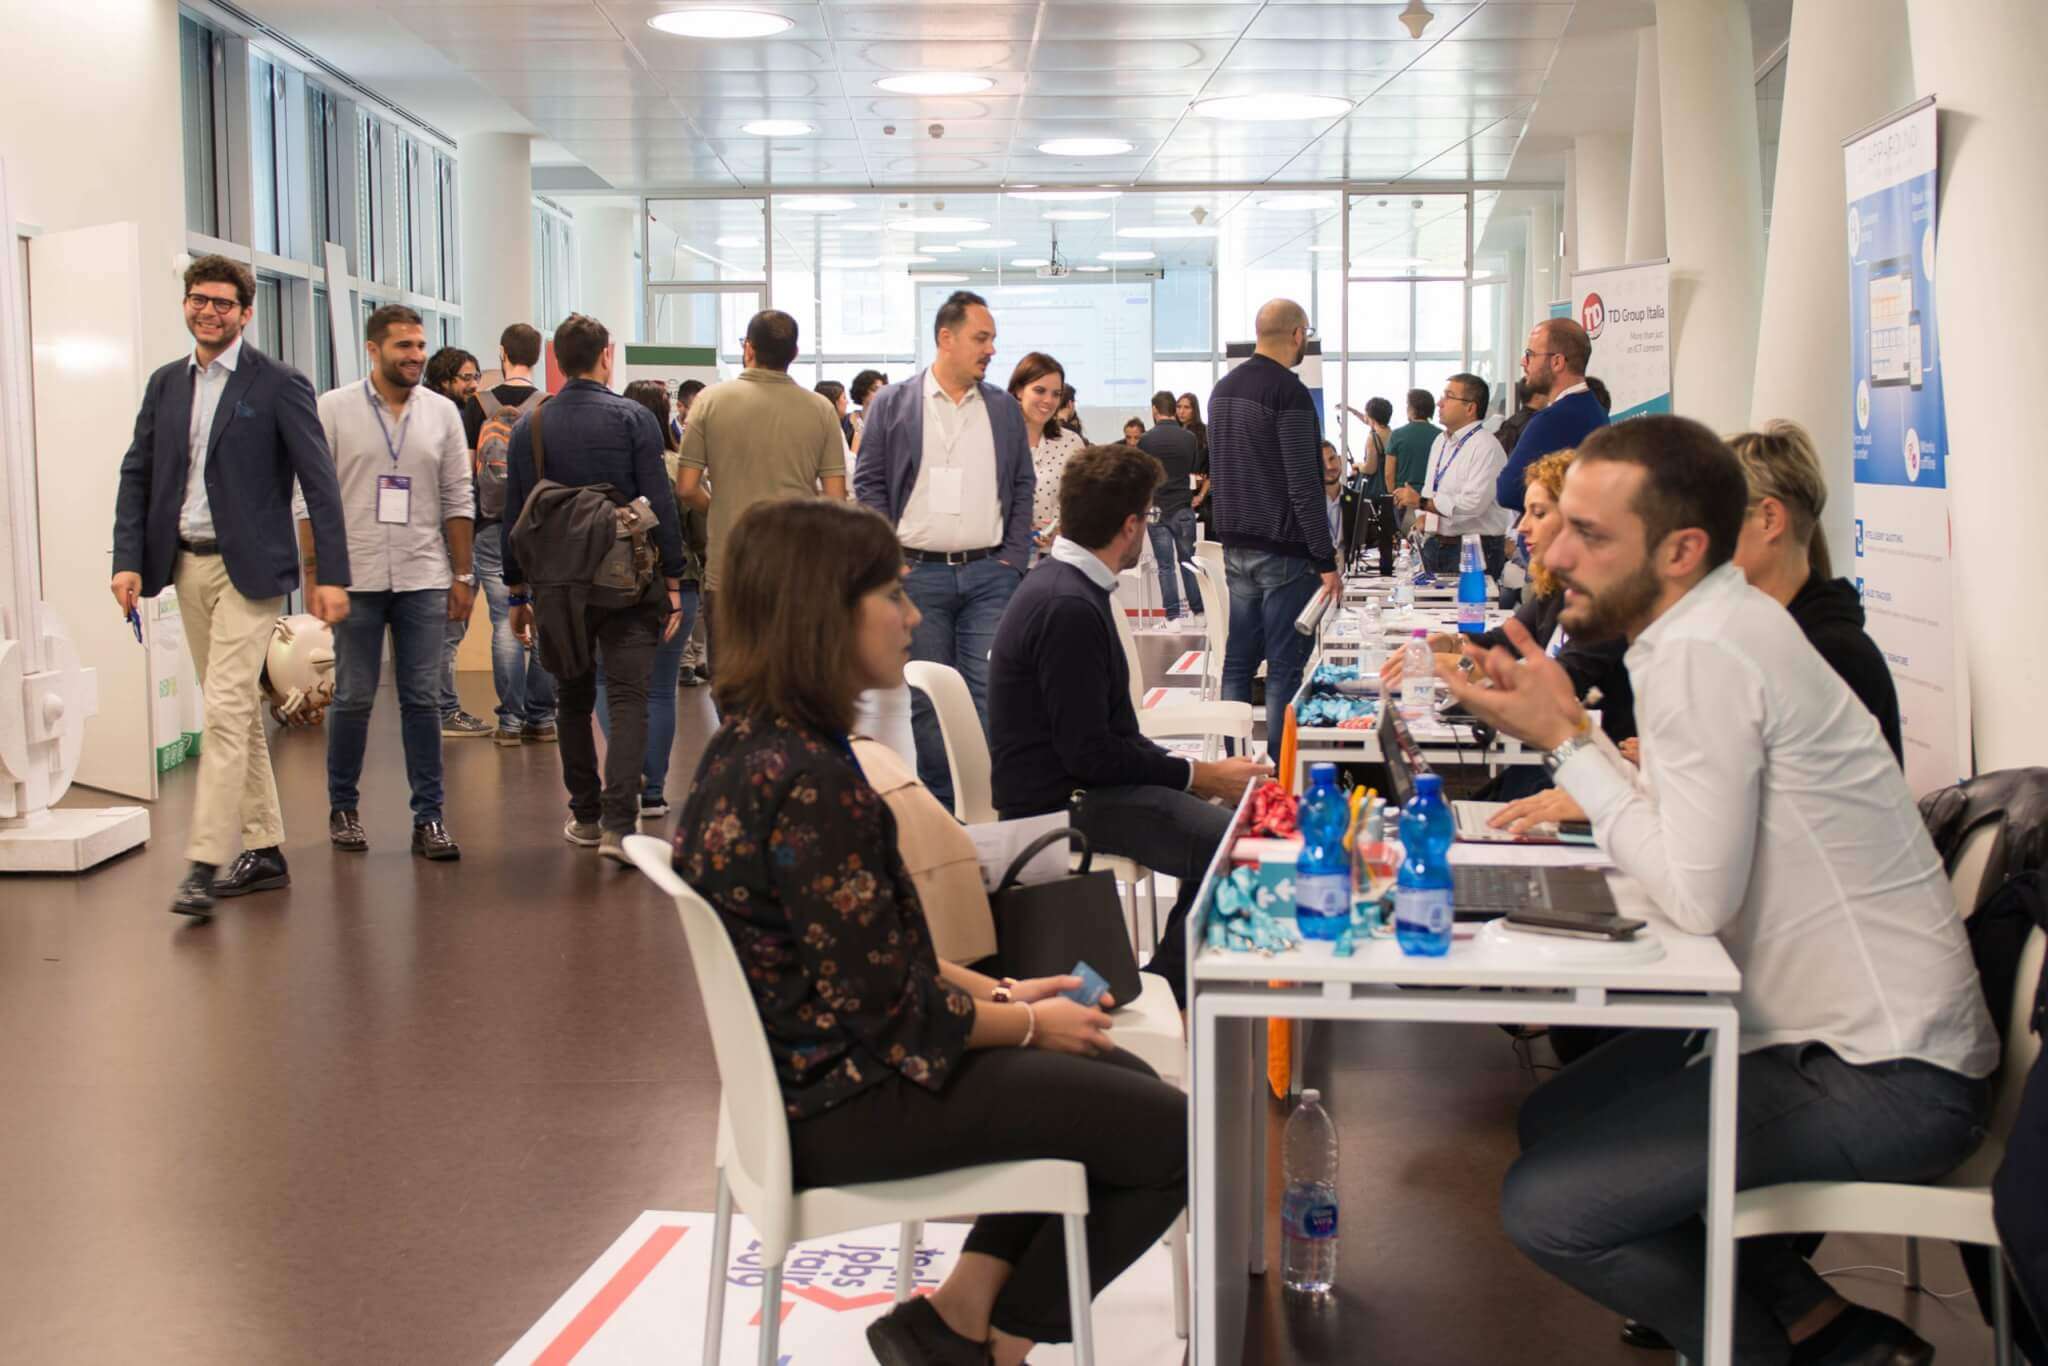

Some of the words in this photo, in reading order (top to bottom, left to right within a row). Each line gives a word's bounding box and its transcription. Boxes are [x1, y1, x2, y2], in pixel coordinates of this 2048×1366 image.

[1584, 303, 1602, 331] TD
[1608, 309, 1620, 323] TD
[1622, 308, 1645, 324] Group
[1646, 304, 1665, 319] Italia
[783, 1249, 850, 1286] fair
[831, 1244, 901, 1288] jobs
